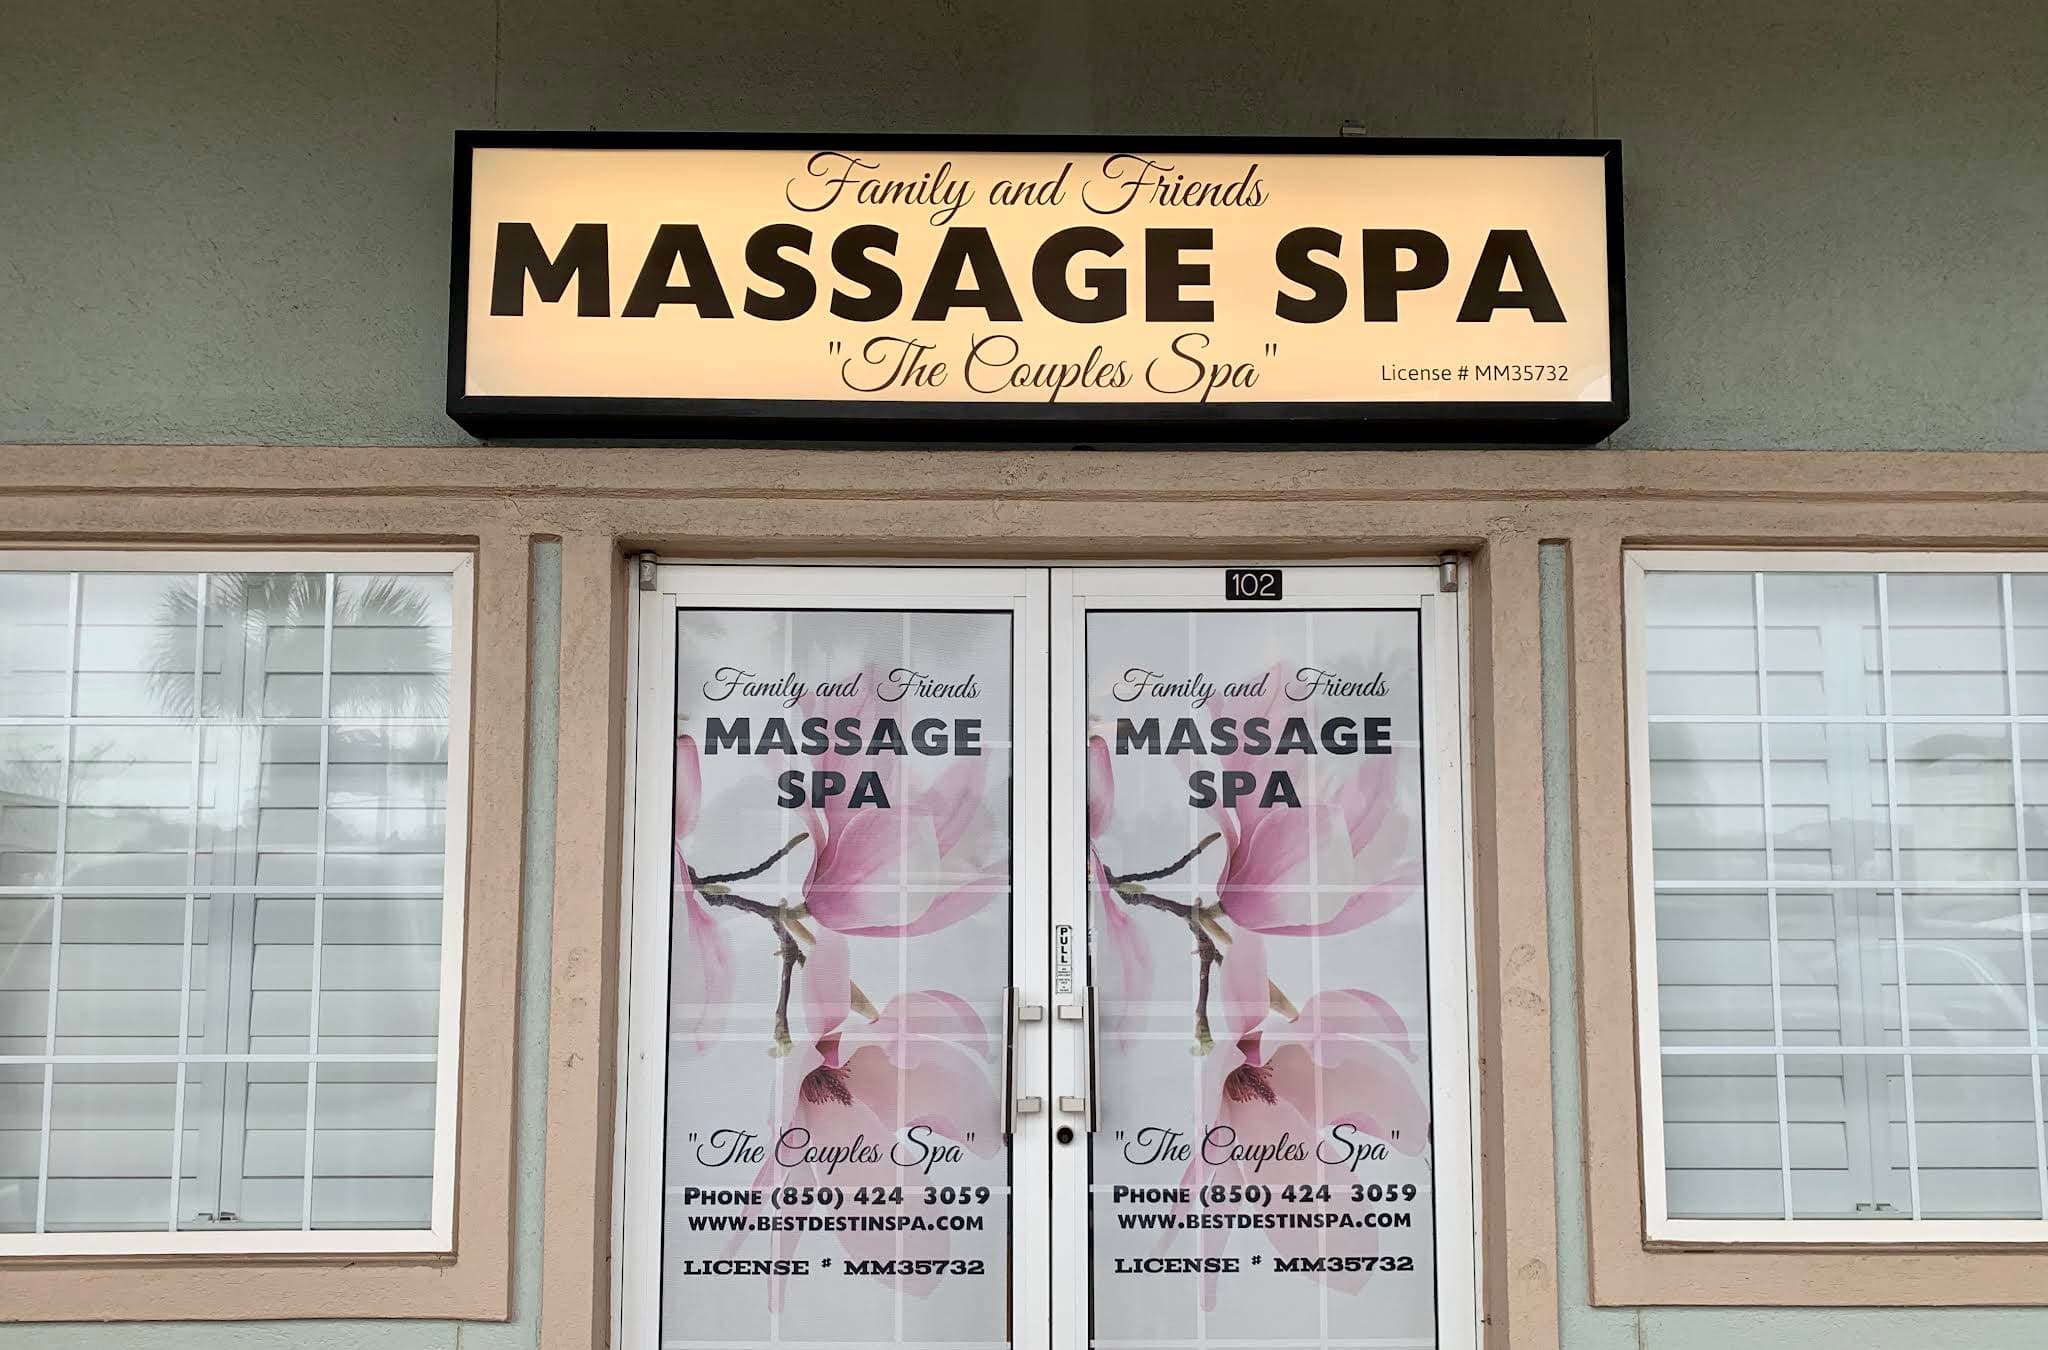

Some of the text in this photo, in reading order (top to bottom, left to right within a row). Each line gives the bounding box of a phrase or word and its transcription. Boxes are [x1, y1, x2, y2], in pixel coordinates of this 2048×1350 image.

[786, 151, 1270, 227] Family and Friends
[490, 222, 1568, 324] MASSAGE SPA
[829, 332, 1277, 402] "The Couples Spa"
[1381, 364, 1569, 382] License # MM35732
[1232, 573, 1276, 597] 102
[703, 667, 981, 708] Family and Friends
[1112, 667, 1389, 708] Family and Friends
[704, 717, 982, 756] MASSAGE
[1115, 717, 1393, 756] MASSAGE
[777, 770, 891, 809] SPA
[1188, 770, 1302, 809] SPA
[1060, 927, 1068, 964] PULL
[689, 1125, 975, 1175] "The Couples Spa"
[1115, 1124, 1400, 1173] "The Couples Spa"
[771, 1187, 844, 1209] (850)
[853, 1187, 904, 1205] 424
[923, 1186, 990, 1205] 3059
[1200, 1185, 1272, 1207] (850)
[1281, 1184, 1331, 1203] 424
[1351, 1184, 1417, 1202] 3059
[688, 1216, 984, 1231] WWW.BESTDESTINSPA.COM
[1118, 1213, 1411, 1229] WWW.BESTDESTINSPA.COM
[684, 1257, 985, 1275] LICENSE # MM35732
[1114, 1255, 1414, 1273] LICENSE # MM35732
